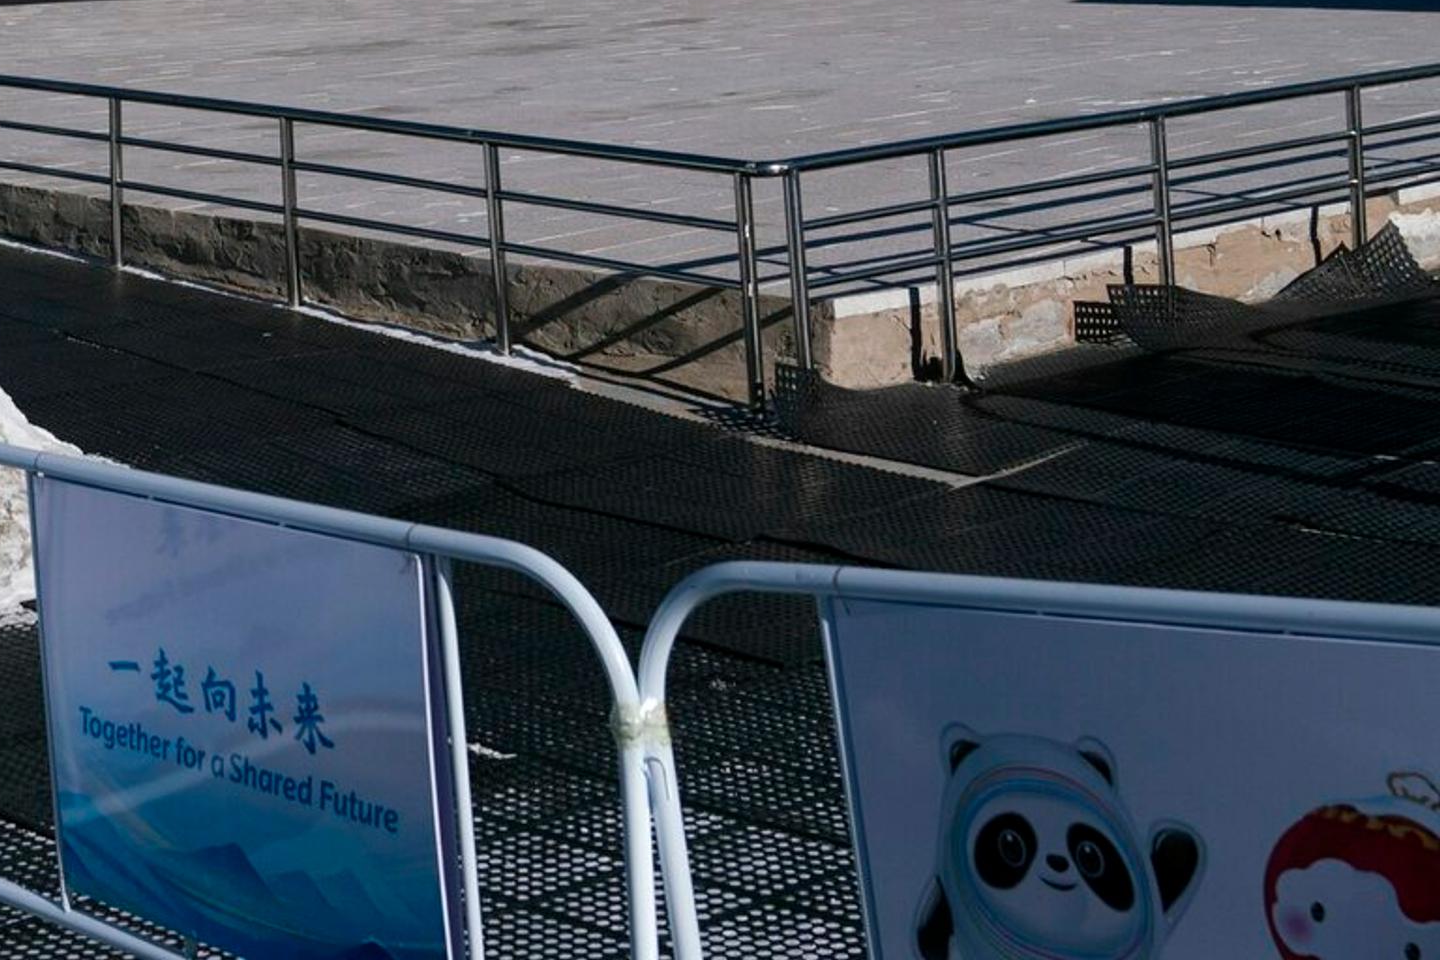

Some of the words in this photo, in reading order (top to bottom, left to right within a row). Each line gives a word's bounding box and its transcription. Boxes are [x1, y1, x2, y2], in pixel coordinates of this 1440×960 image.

[108, 647, 335, 755] 一起向未来
[78, 705, 171, 759] Together
[175, 736, 206, 772] for
[210, 754, 225, 778] a
[229, 753, 313, 807] Shared
[319, 779, 399, 833] Future
